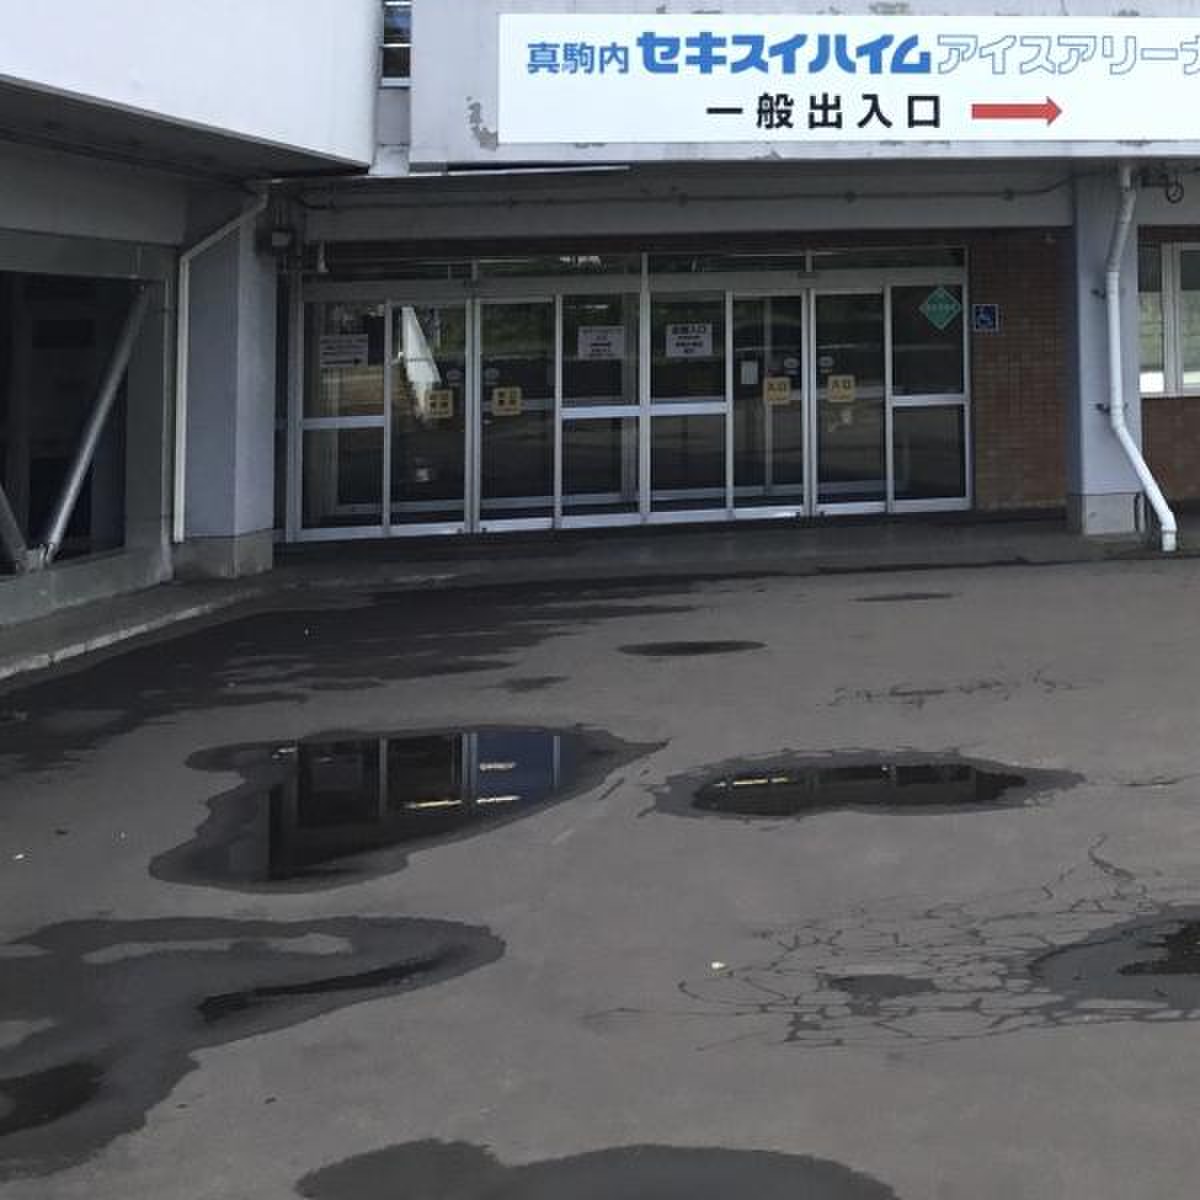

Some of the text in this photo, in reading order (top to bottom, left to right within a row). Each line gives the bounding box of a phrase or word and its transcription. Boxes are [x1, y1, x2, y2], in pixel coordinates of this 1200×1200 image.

[705, 92, 941, 129] 一般出入口
